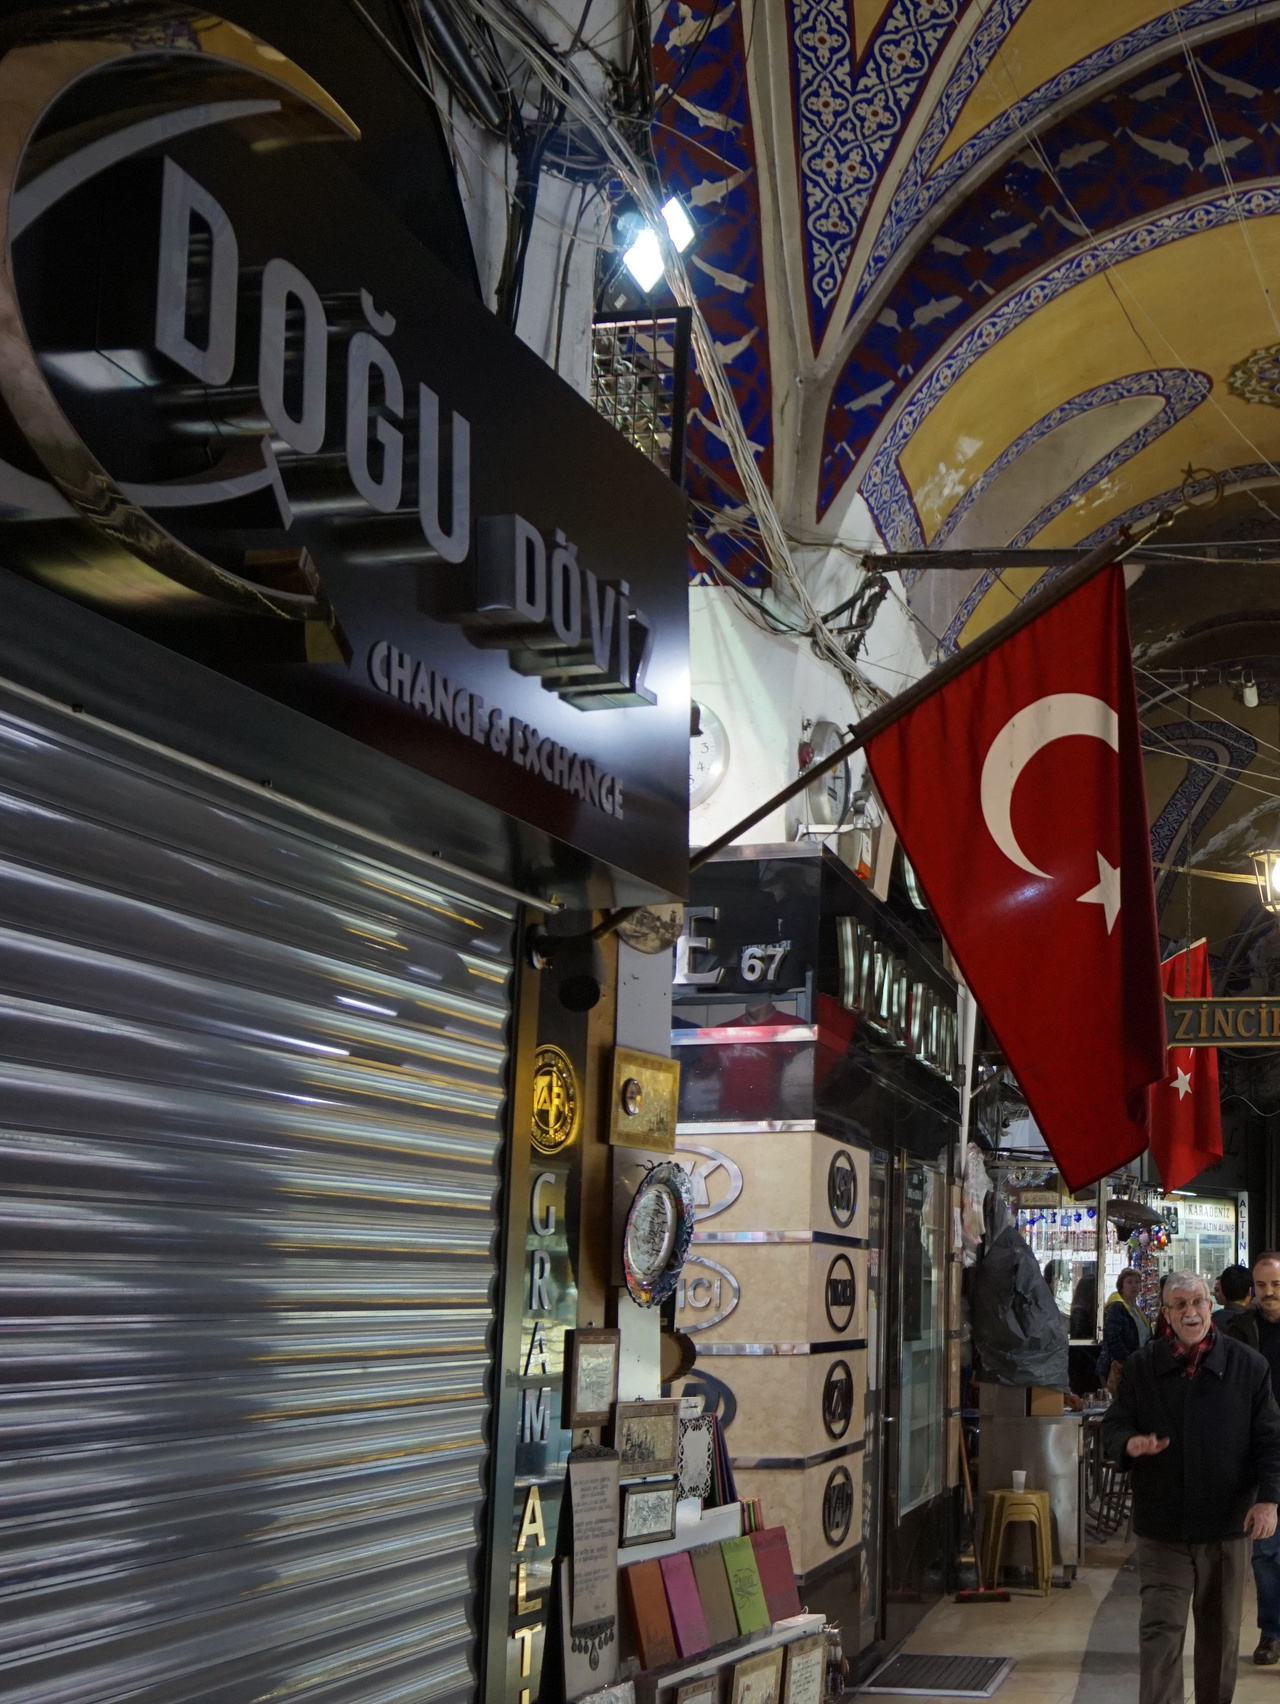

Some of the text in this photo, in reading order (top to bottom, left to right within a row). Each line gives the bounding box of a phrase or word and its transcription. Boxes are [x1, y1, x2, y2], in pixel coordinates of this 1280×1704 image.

[154, 155, 470, 562] DOĞU
[741, 947, 787, 982] 67
[1188, 1204, 1230, 1218] KARADENİZ
[1203, 1222, 1218, 1231] ALTIN
[1218, 1223, 1235, 1233] ALINIR
[1239, 1199, 1247, 1250] ALTIN
[523, 1171, 557, 1443] GRAM
[512, 1485, 546, 1704] ALT
